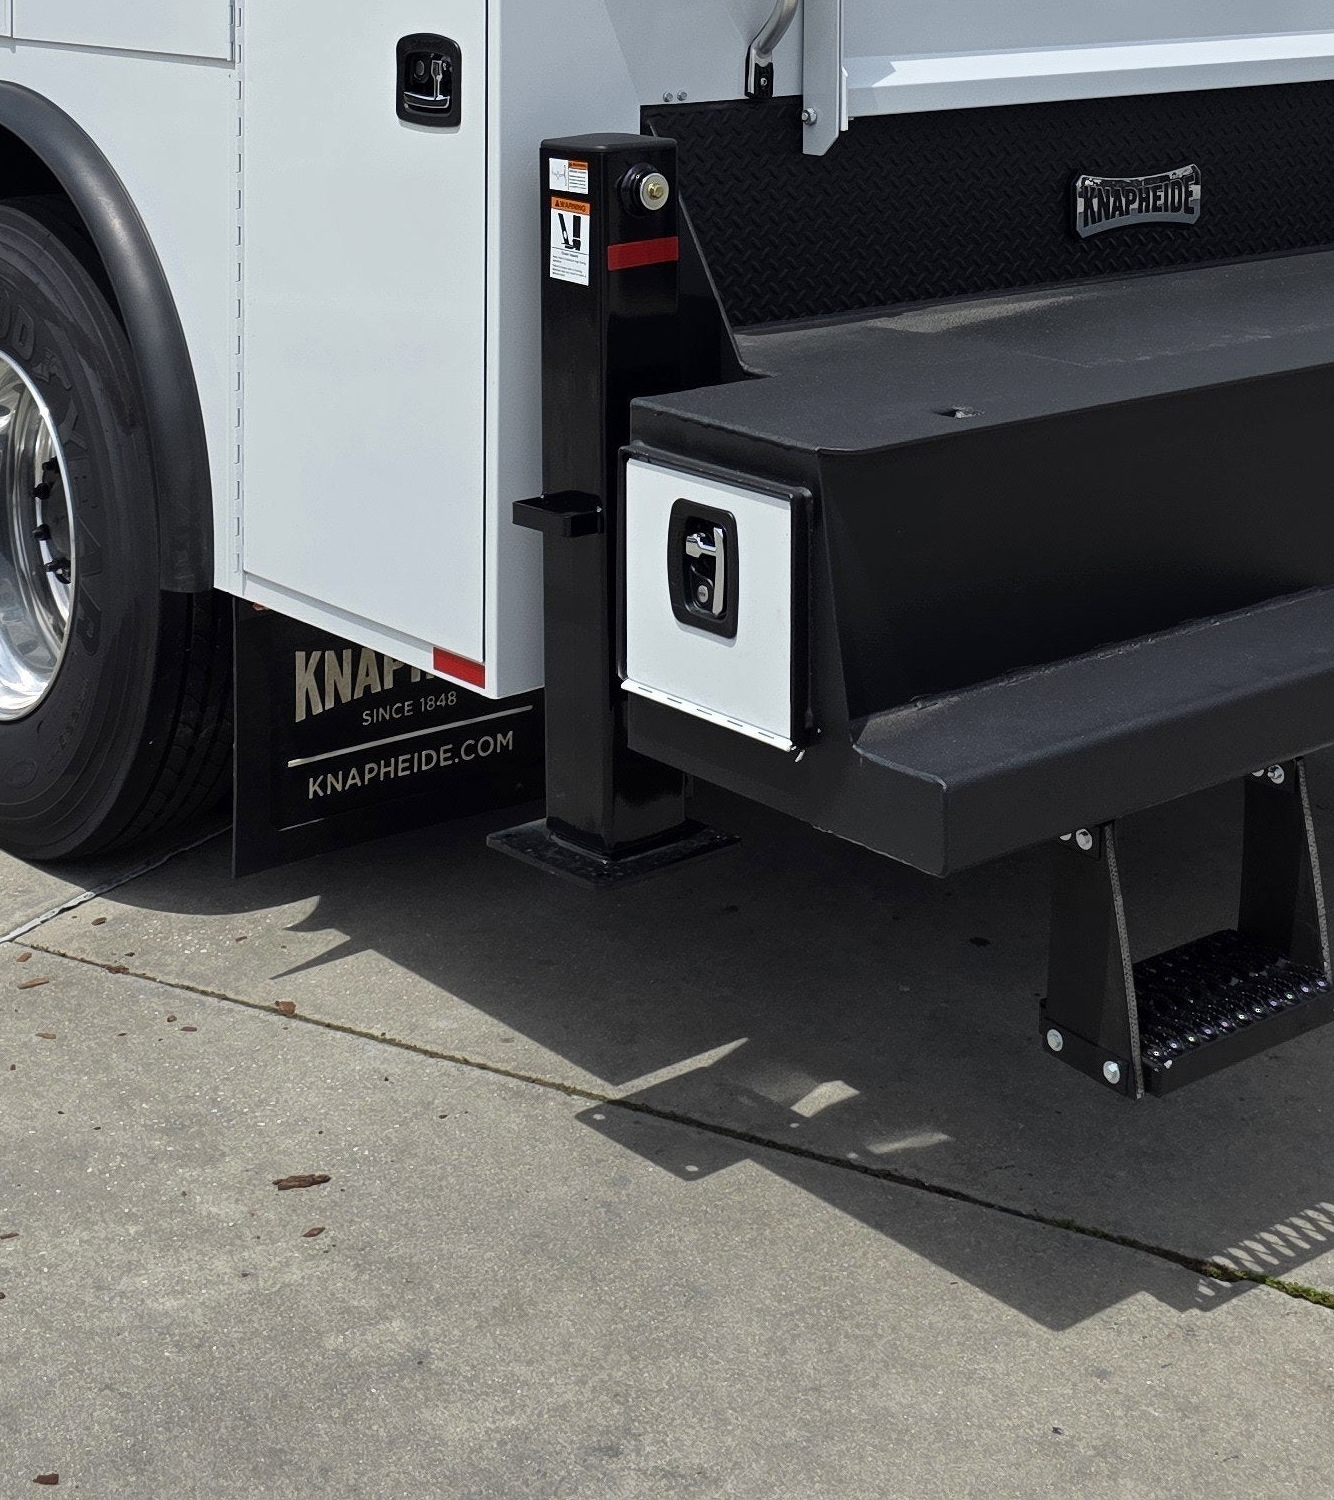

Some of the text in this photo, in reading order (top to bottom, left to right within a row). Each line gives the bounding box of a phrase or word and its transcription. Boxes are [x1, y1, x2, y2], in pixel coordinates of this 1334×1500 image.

[559, 200, 587, 213] WARNING
[1082, 172, 1196, 228] KNAPHEIDE
[362, 690, 457, 726] SINCE 1848
[308, 730, 514, 800] KNAPHEIDE.COM
